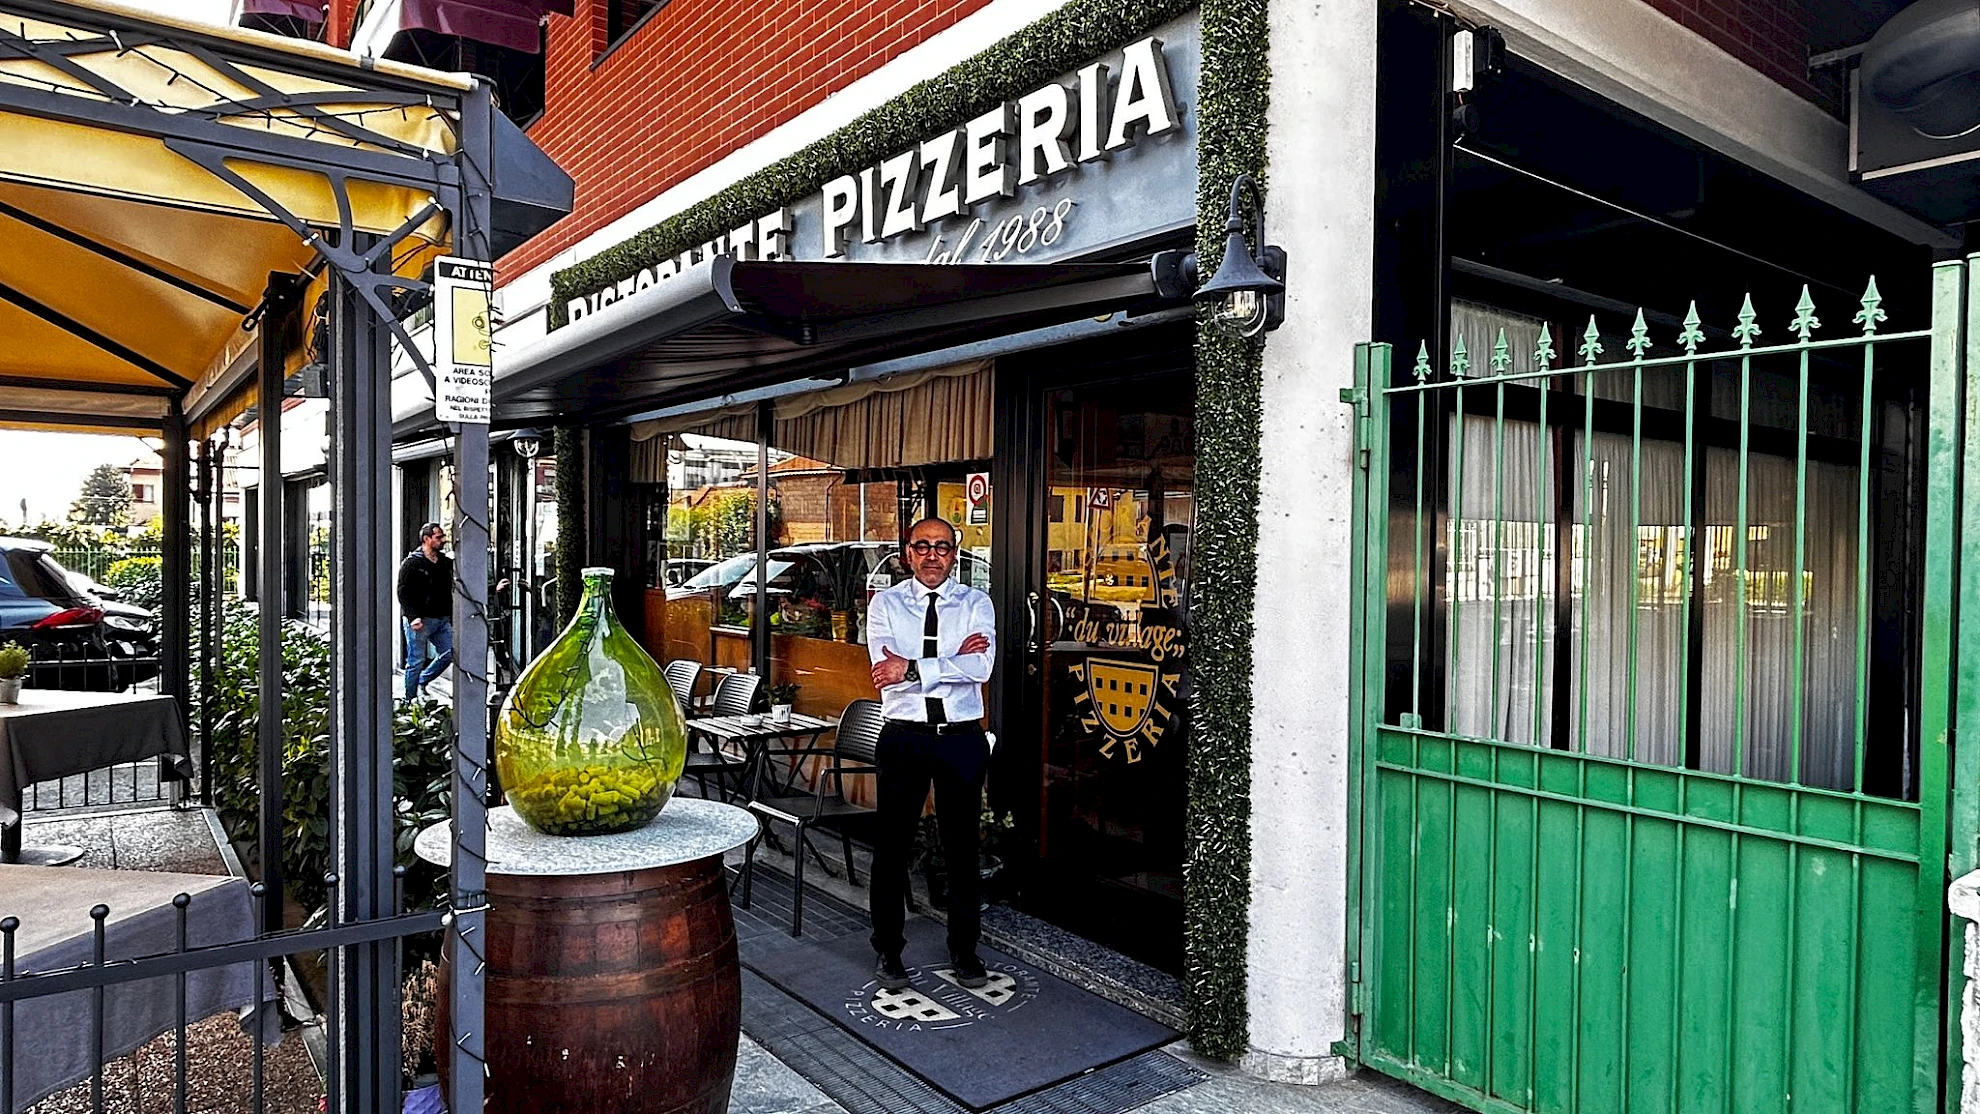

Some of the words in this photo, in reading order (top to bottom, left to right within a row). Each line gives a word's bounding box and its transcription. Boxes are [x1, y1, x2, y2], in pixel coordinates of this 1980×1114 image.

[822, 37, 1174, 258] PIZZERIA
[979, 197, 1072, 264] 1988
[453, 367, 475, 375] AREA
[445, 395, 479, 404] RAGIONI
[1068, 662, 1181, 764] PIZZERIA
[844, 989, 922, 1032] PIZZERIA
